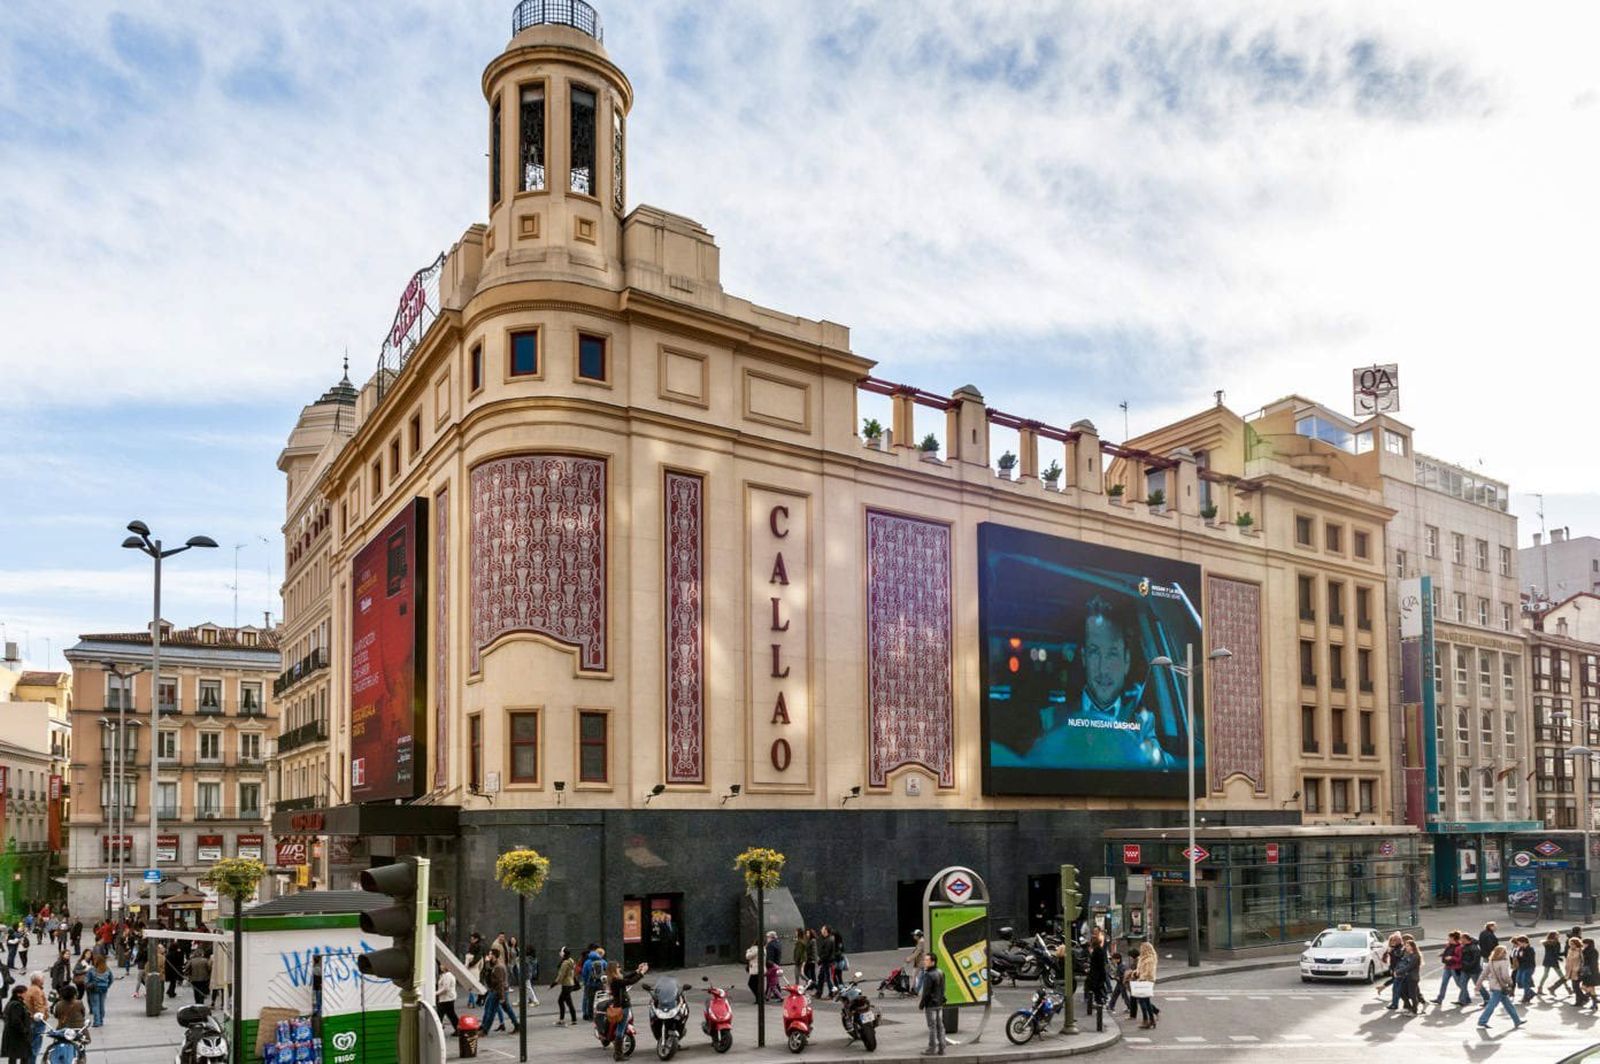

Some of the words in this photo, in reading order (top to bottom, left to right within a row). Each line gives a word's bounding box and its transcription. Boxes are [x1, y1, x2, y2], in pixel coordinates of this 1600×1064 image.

[769, 505, 792, 772] CALLAO
[1068, 718, 1089, 727] NUEVO
[1091, 719, 1112, 728] NISSAN
[333, 1053, 356, 1063] FRIGO
